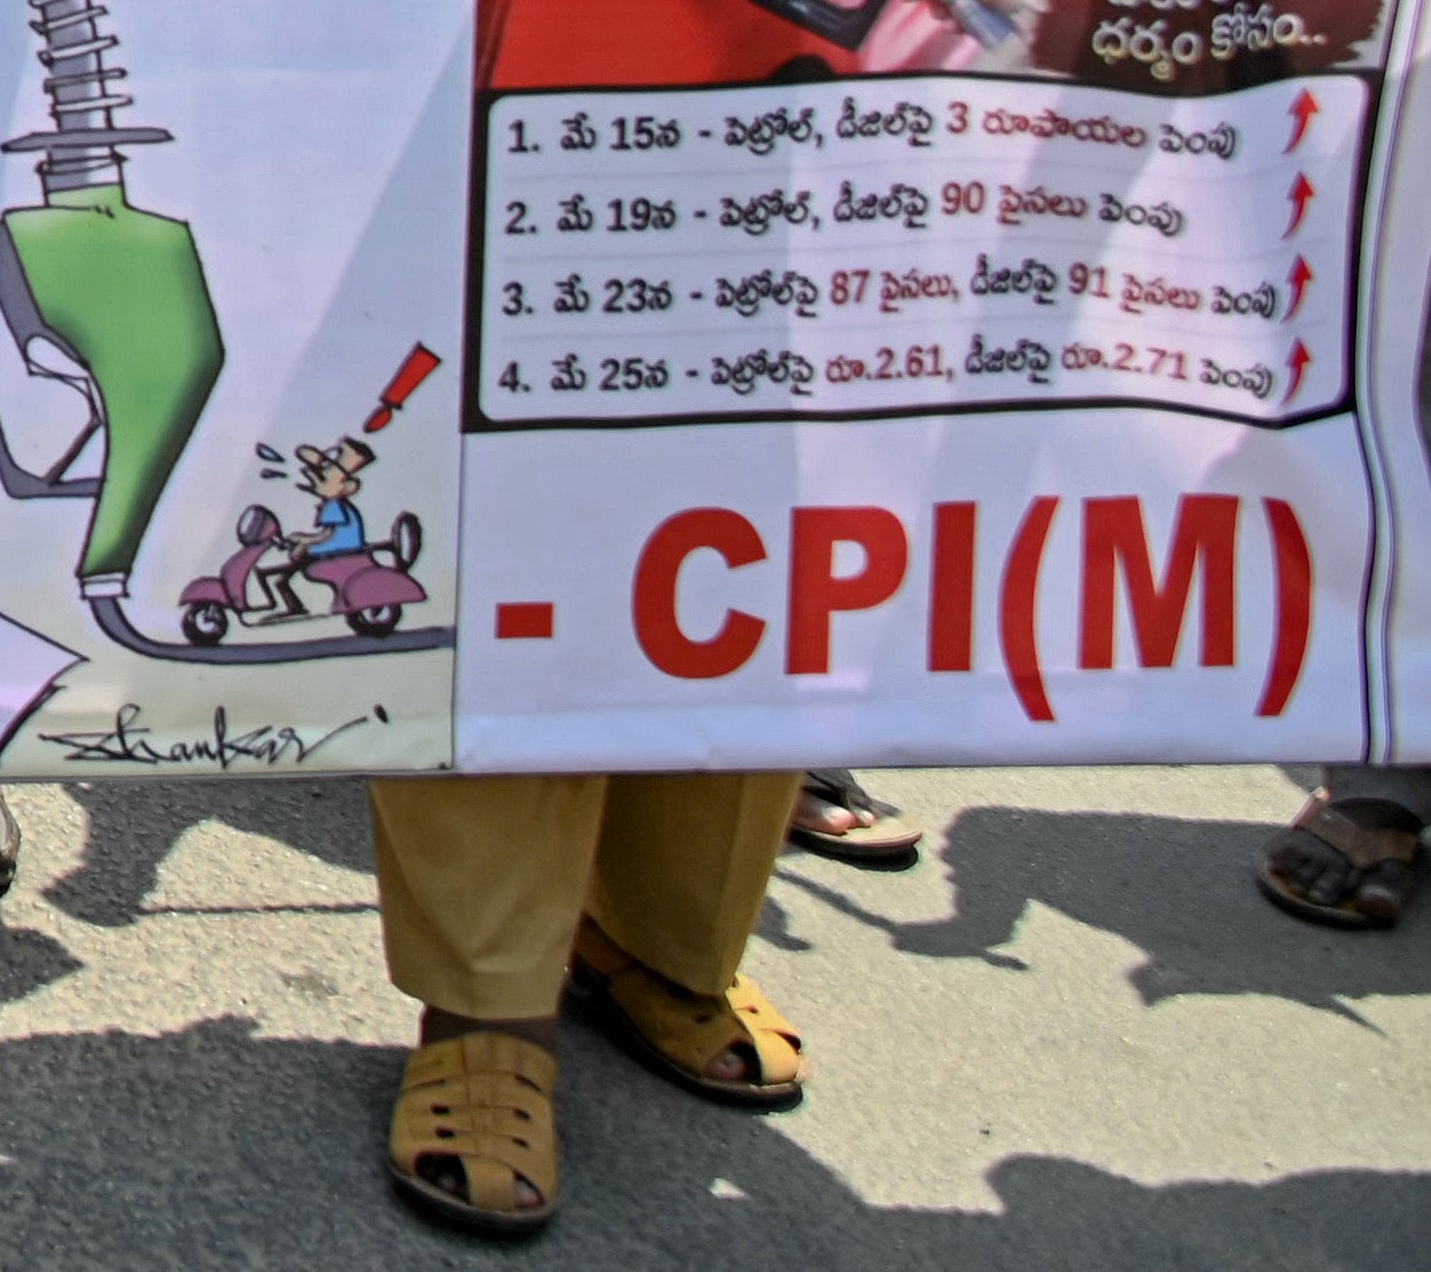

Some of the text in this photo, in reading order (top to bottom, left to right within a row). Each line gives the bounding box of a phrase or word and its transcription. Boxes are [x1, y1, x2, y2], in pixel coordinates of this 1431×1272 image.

[560, 110, 598, 151] మే
[947, 100, 970, 134] 3
[629, 492, 1315, 724] CPI(M)
